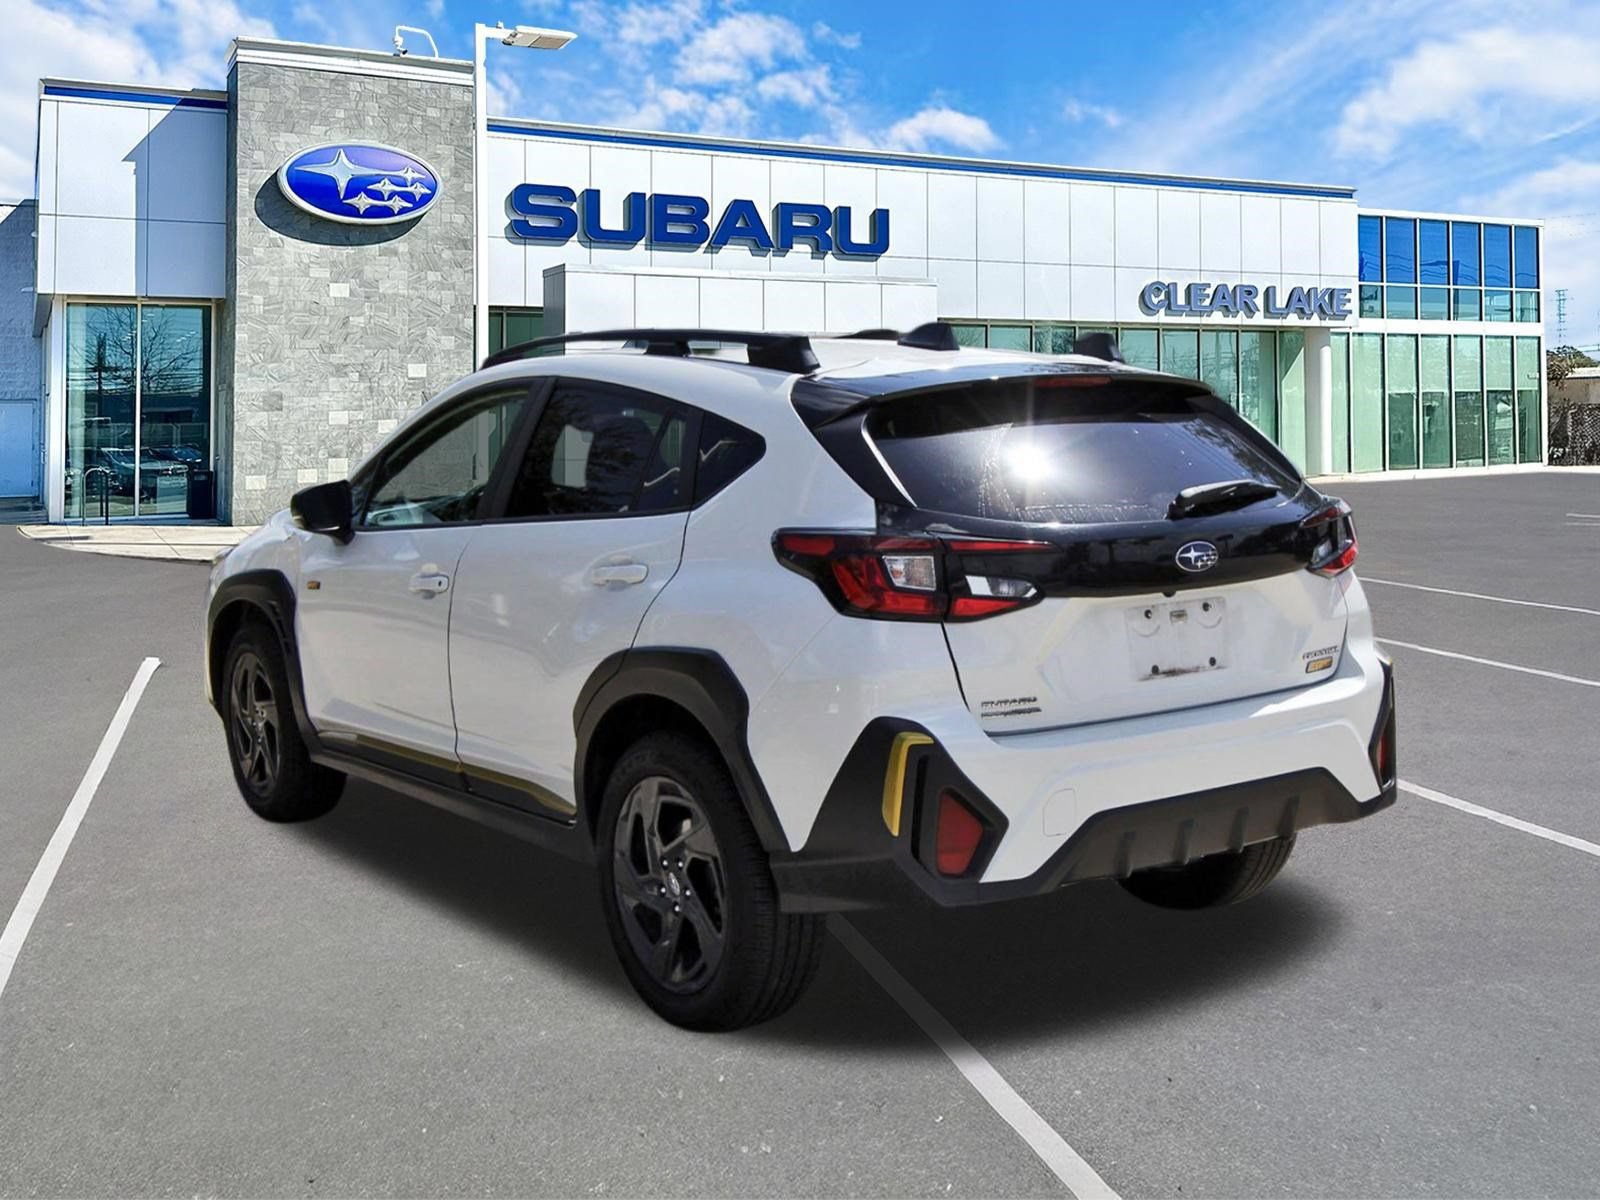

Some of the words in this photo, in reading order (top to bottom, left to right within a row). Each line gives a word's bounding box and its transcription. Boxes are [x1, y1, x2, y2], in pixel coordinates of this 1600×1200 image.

[505, 183, 889, 260] SUBARU
[1140, 281, 1260, 318] CLEAR
[1264, 286, 1352, 320] LAKE
